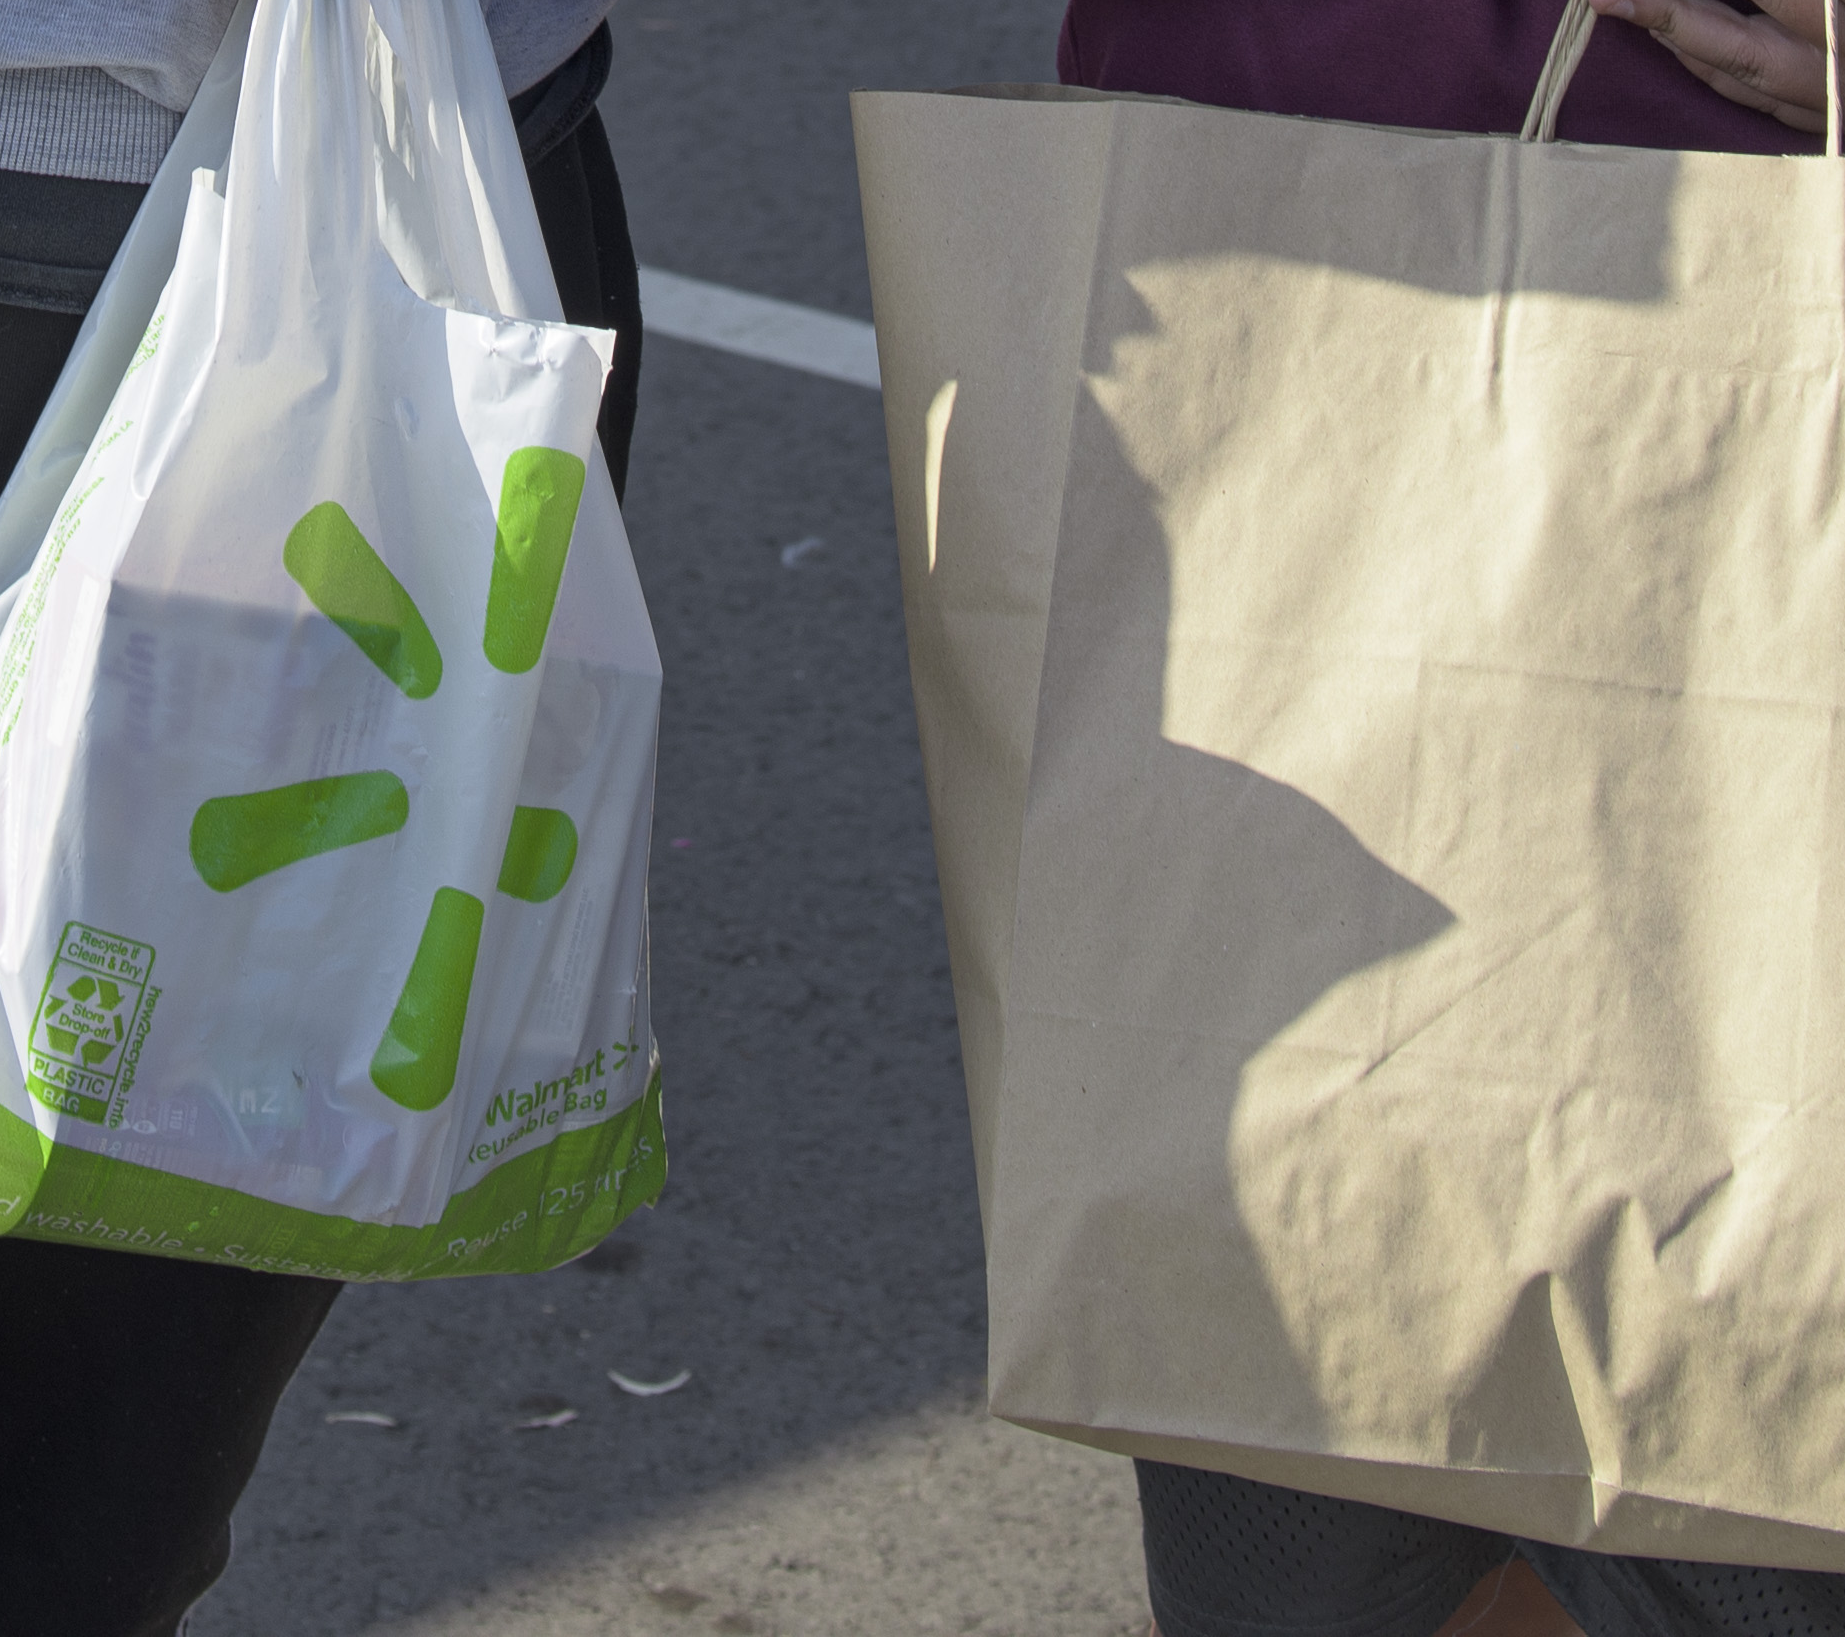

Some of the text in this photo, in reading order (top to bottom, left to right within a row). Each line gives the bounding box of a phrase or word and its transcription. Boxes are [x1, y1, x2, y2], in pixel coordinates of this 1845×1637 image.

[67, 942, 143, 980] Clean & Dry
[79, 930, 141, 960] Recycle if
[58, 1013, 111, 1040] Drop-off
[72, 1003, 105, 1024] Store
[33, 1057, 105, 1096] PLASTIC
[486, 1048, 606, 1126] Walmart
[42, 1088, 80, 1114] BAG
[564, 1088, 607, 1116] Bag
[24, 1211, 184, 1251] washable
[447, 1210, 528, 1258] Reuse
[538, 1179, 587, 1219] 125
